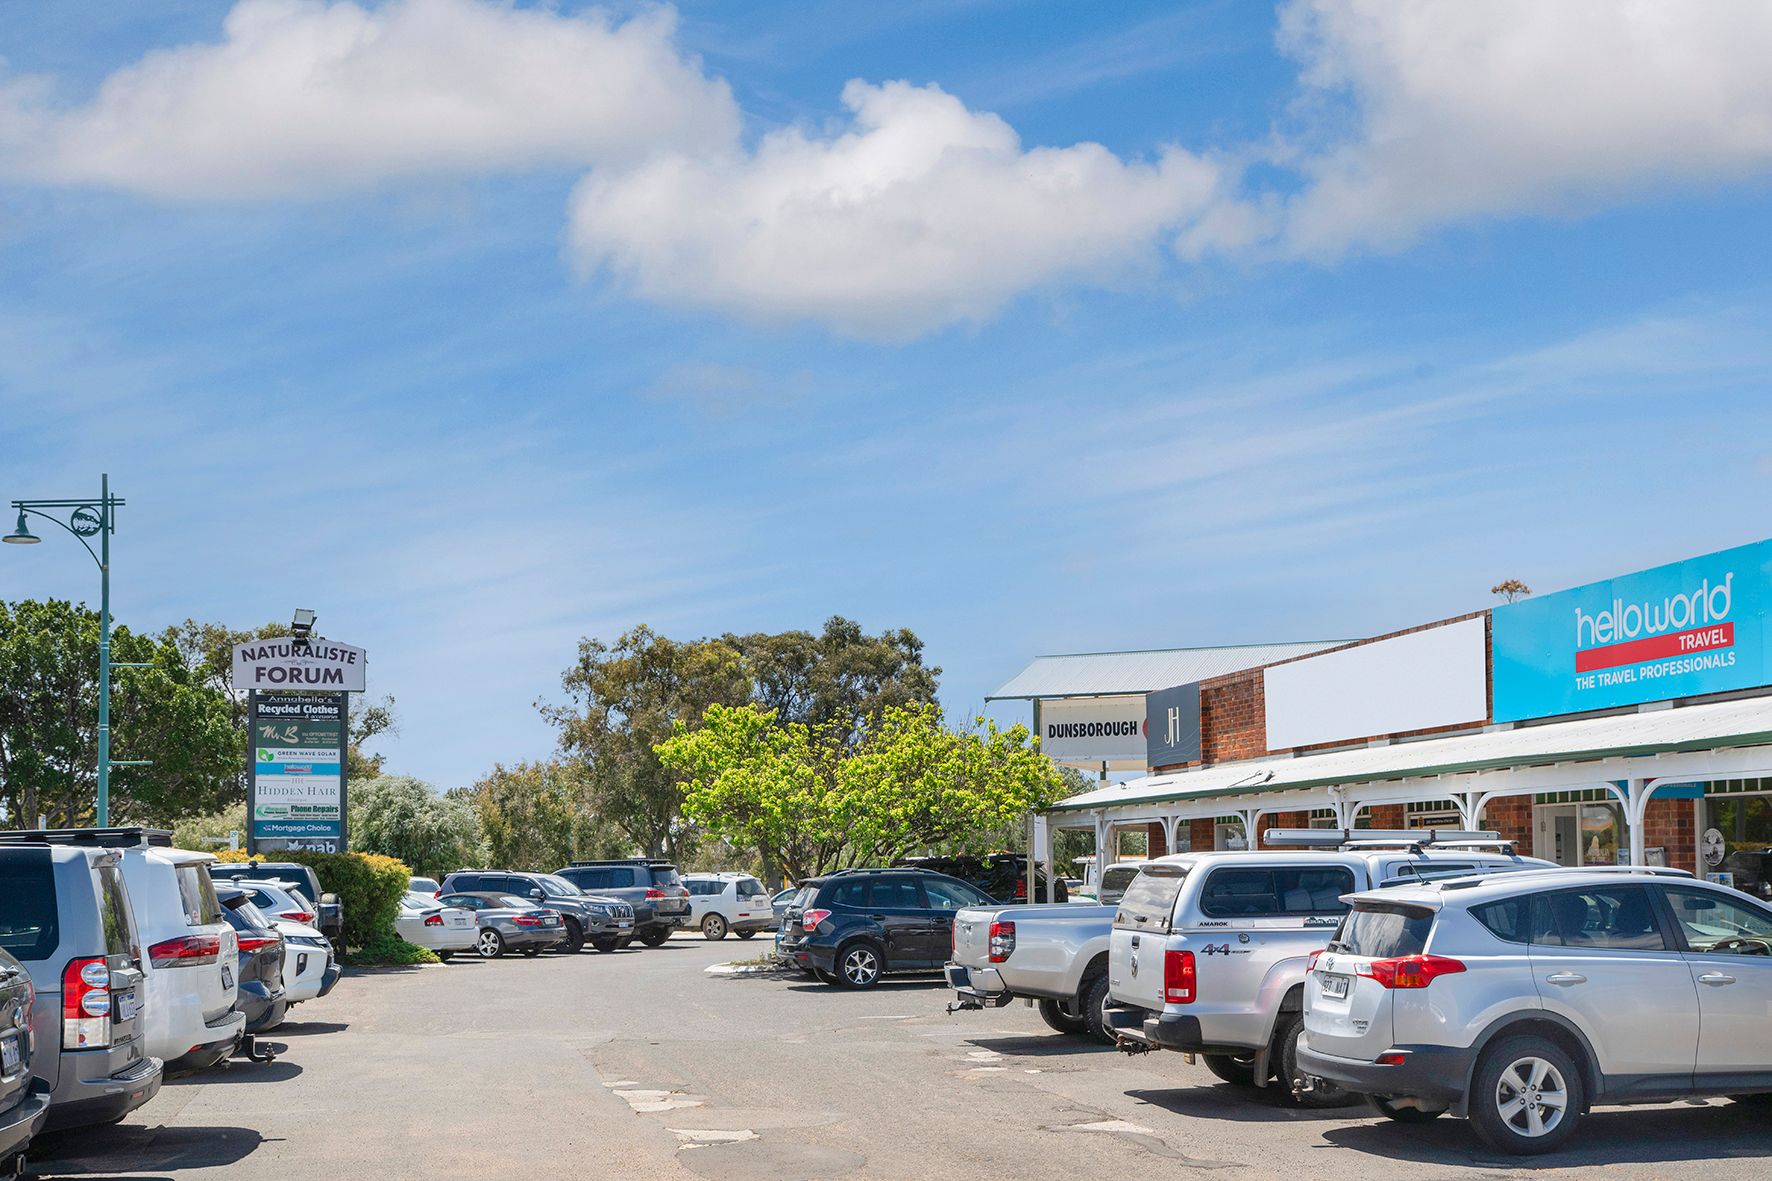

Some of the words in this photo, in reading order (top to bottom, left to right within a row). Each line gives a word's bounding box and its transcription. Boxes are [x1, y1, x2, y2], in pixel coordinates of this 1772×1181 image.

[1678, 628, 1728, 651] TRAVEL
[241, 644, 357, 665] NATURALISTE
[255, 666, 344, 684] FORUM
[1575, 676, 1596, 690] THE
[1597, 667, 1637, 687] TRAVEL
[1639, 651, 1736, 679] PROFESSIONALS
[258, 703, 300, 715] Recycled
[303, 704, 339, 714] Clothes
[1048, 720, 1138, 739] DUNSBOROUGH
[258, 786, 304, 796] HIDDEN
[307, 786, 337, 796] HAIR
[290, 805, 312, 813] Phone
[313, 805, 339, 814] Repairs
[271, 824, 306, 832] Mortgage
[306, 824, 332, 832] Choice
[306, 841, 336, 854] nab
